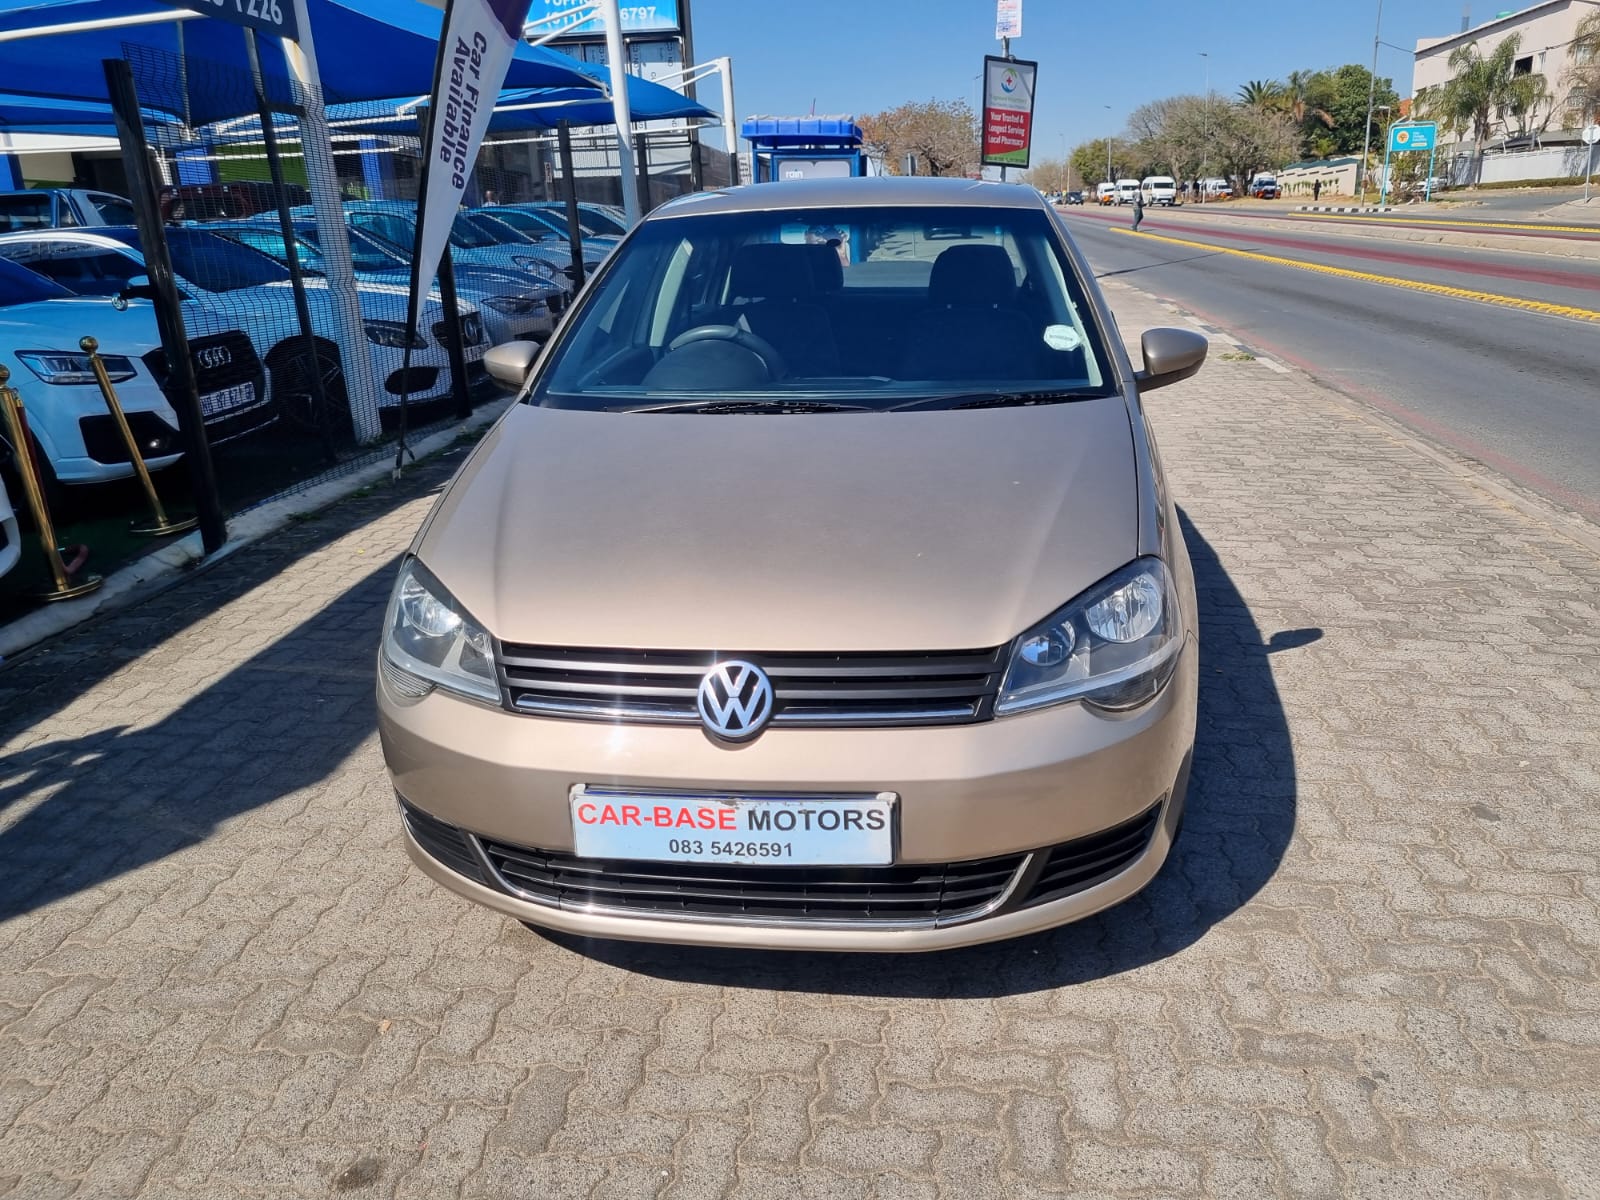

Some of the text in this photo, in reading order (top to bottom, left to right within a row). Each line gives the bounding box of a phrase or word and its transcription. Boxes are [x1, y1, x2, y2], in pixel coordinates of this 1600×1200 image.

[440, 36, 470, 164] Available
[452, 31, 487, 190] Car Finance
[577, 803, 886, 832] CAR-BASE MOTORS
[669, 839, 793, 857] 083 5426591
